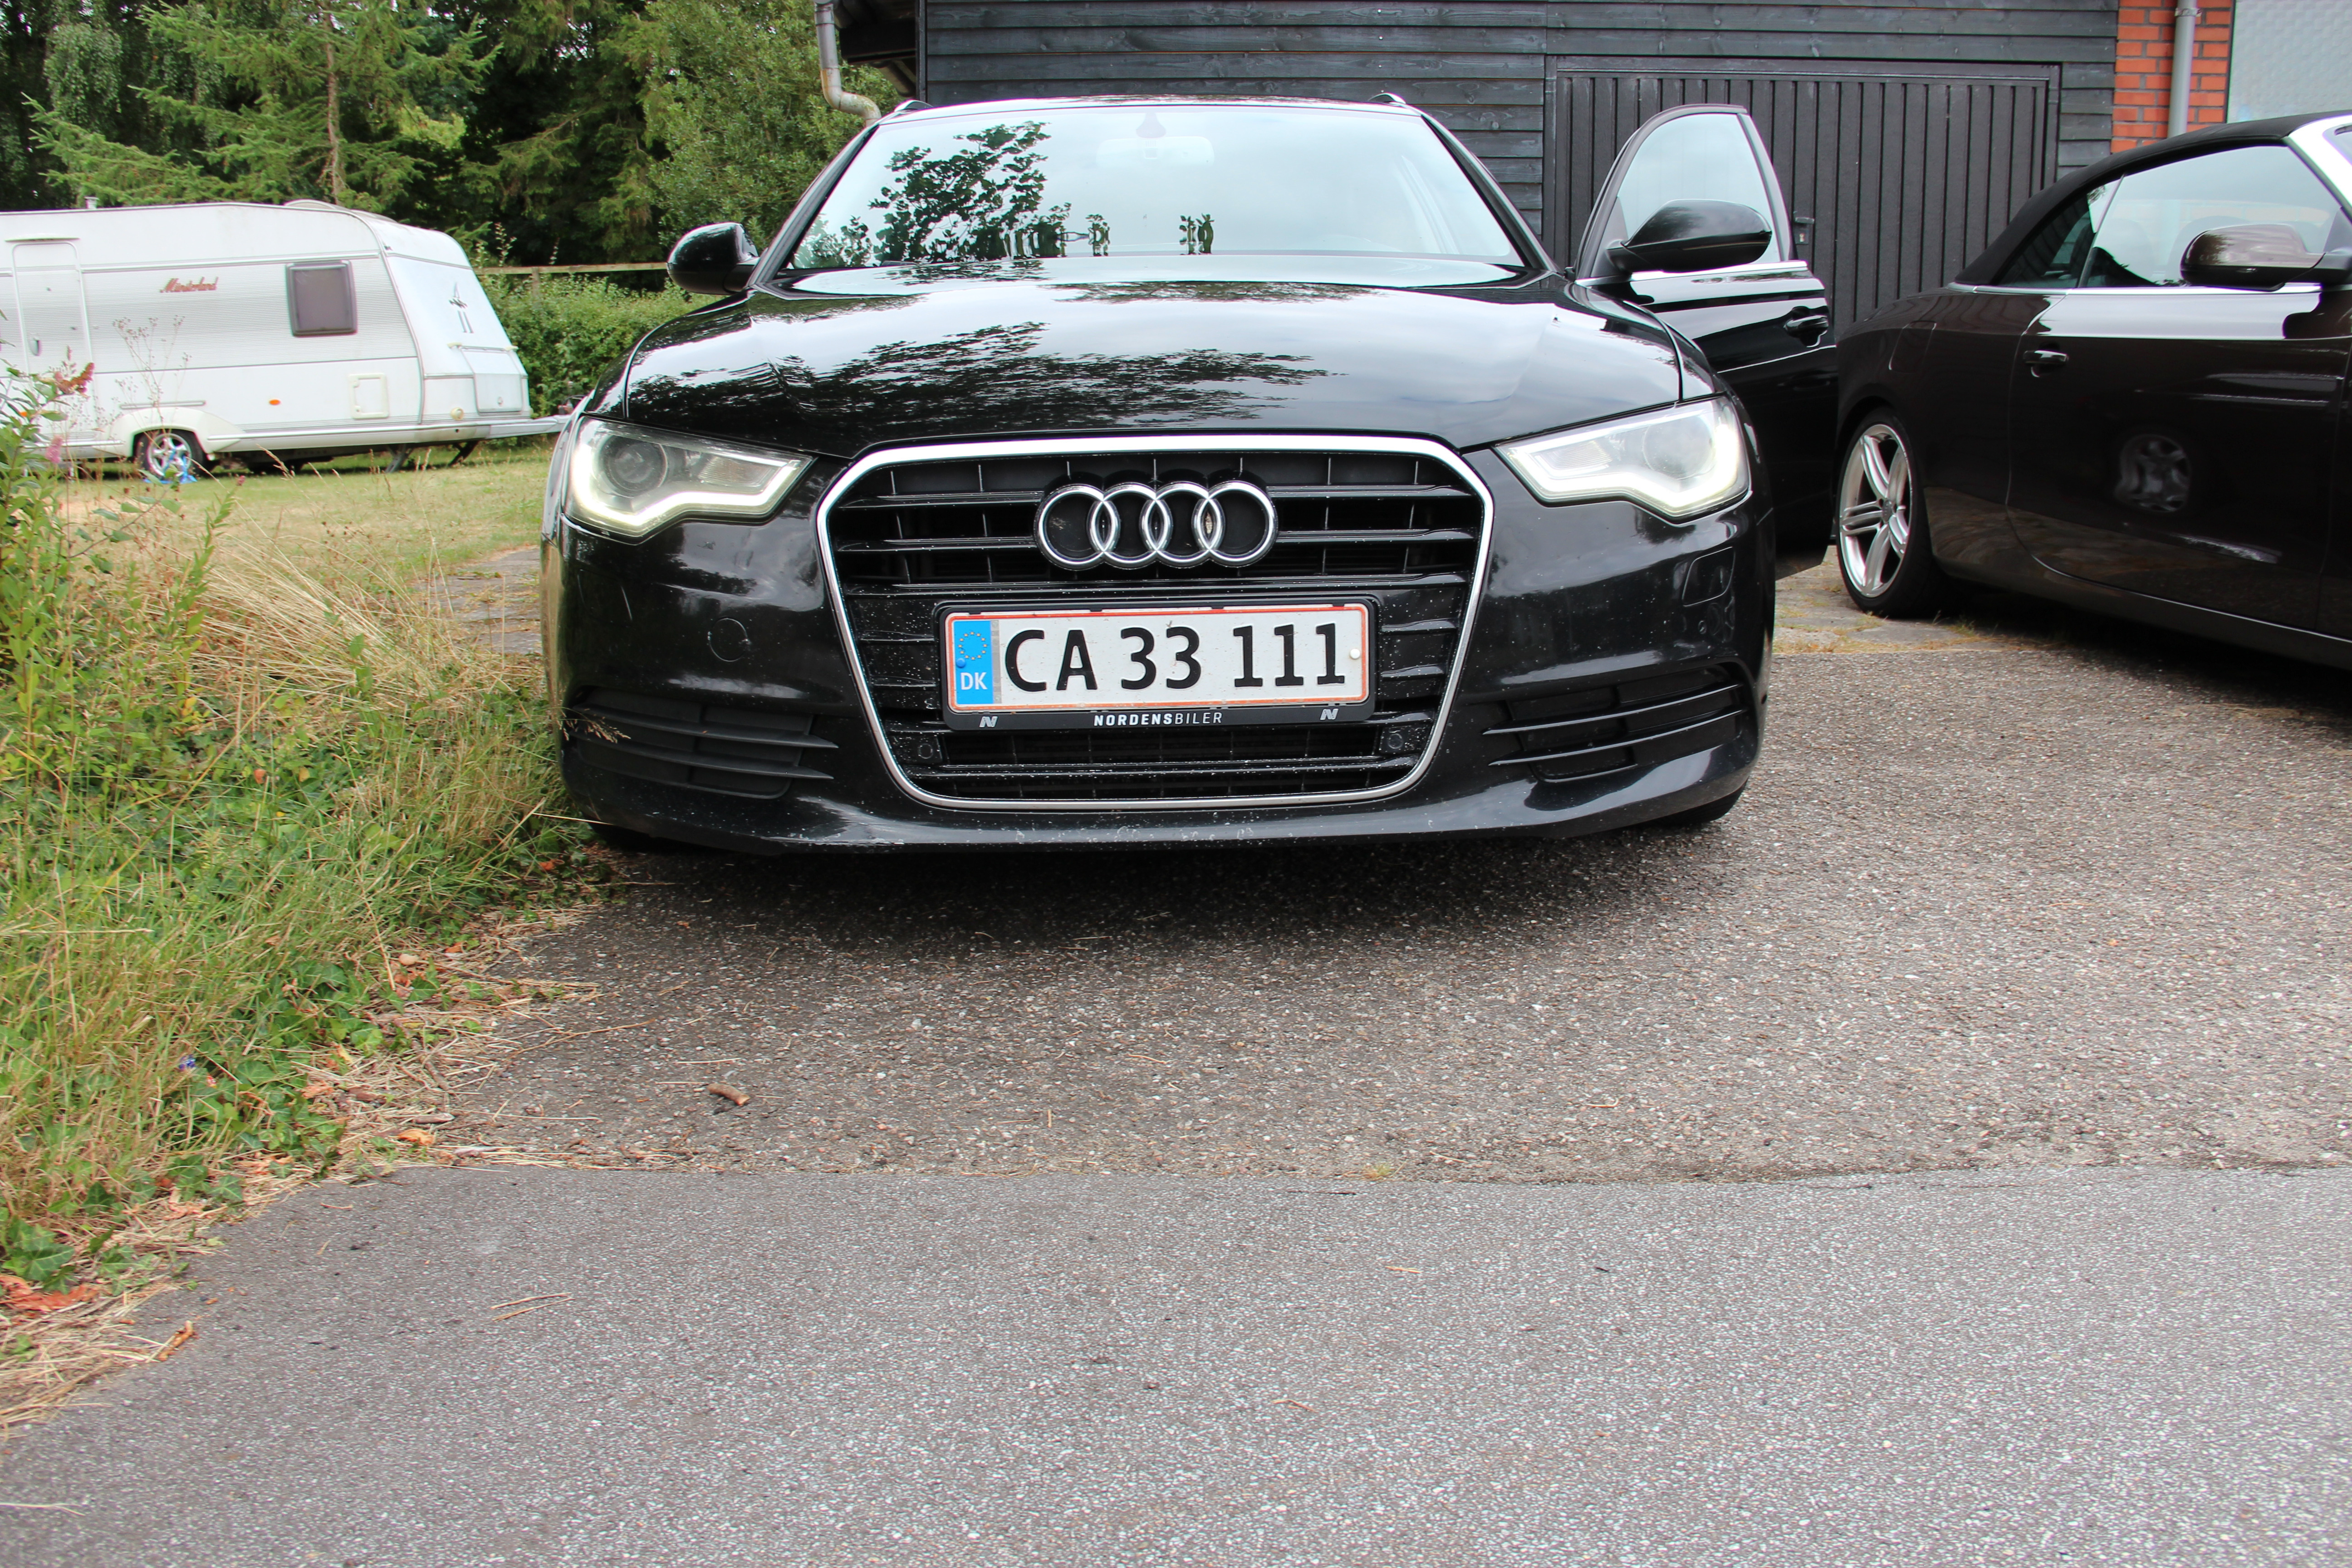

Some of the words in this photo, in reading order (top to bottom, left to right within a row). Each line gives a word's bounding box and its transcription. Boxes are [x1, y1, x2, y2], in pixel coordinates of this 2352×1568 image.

[1005, 629, 1098, 692] CA
[1121, 627, 1201, 690] 33
[1233, 623, 1345, 687] 111
[960, 671, 988, 690] DK
[1093, 712, 1223, 726] NORDENSBILER
